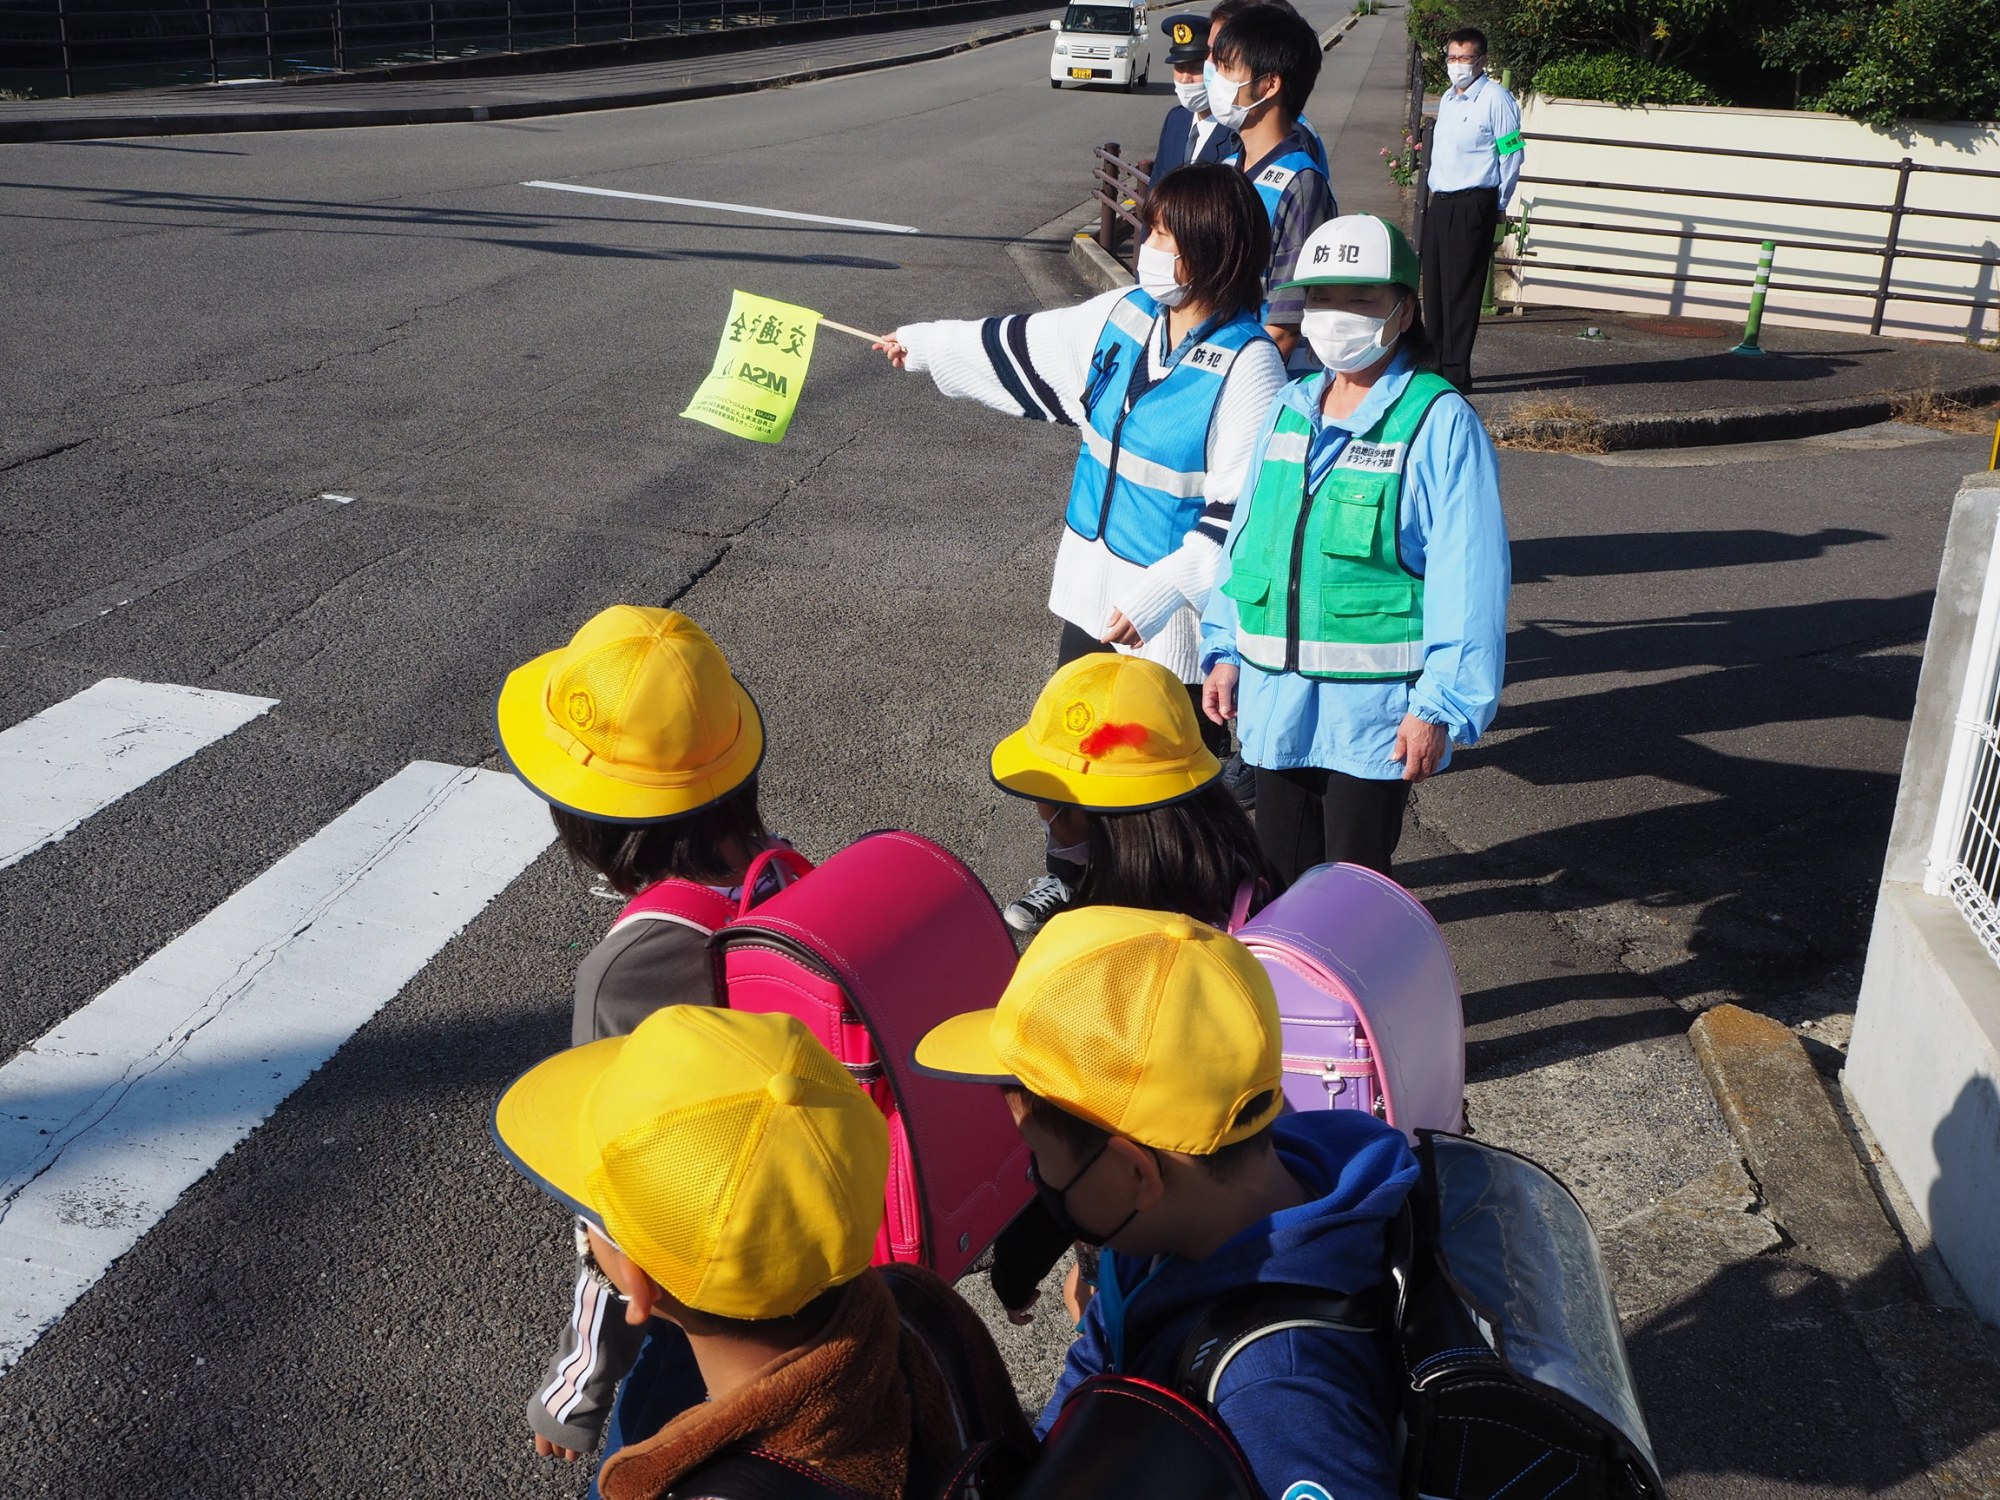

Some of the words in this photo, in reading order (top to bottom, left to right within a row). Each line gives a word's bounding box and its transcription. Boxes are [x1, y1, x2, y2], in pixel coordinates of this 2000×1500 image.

[1263, 169, 1285, 183] 防犯
[1313, 244, 1360, 264] 防犯
[1191, 347, 1223, 368] 防犯
